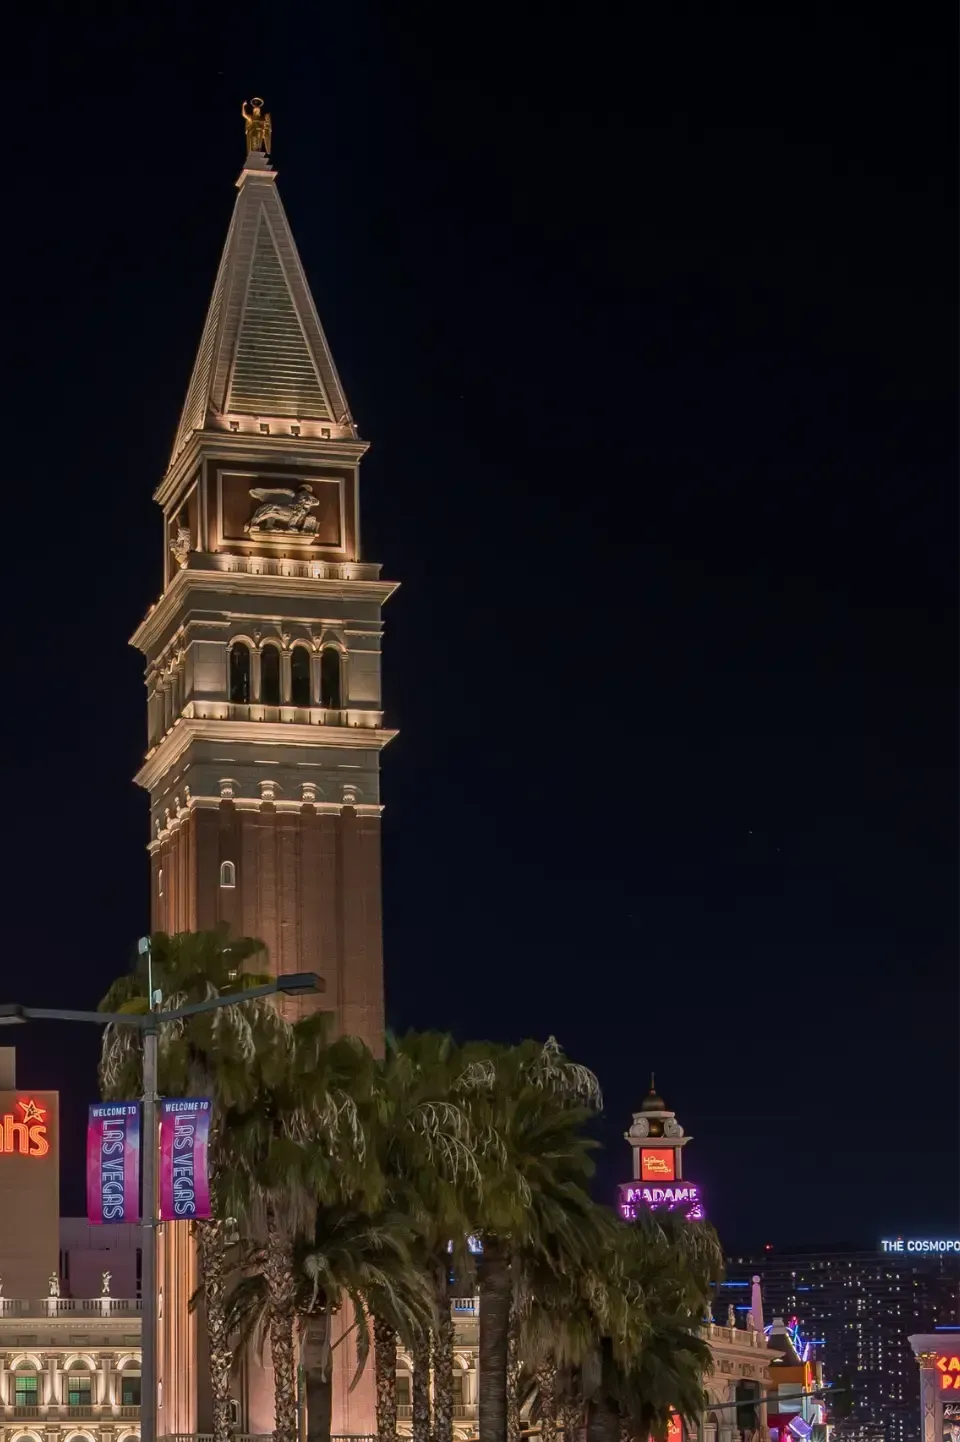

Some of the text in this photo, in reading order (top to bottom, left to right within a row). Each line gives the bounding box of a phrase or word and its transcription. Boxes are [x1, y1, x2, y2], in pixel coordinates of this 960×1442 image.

[93, 1106, 137, 1117] WELCOME TO
[164, 1102, 209, 1112] WELCOME TO
[102, 1119, 124, 1219] LAS VEGAS
[173, 1114, 196, 1214] LAS VEGAS
[627, 1189, 699, 1202] MADAME
[881, 1240, 904, 1252] THE
